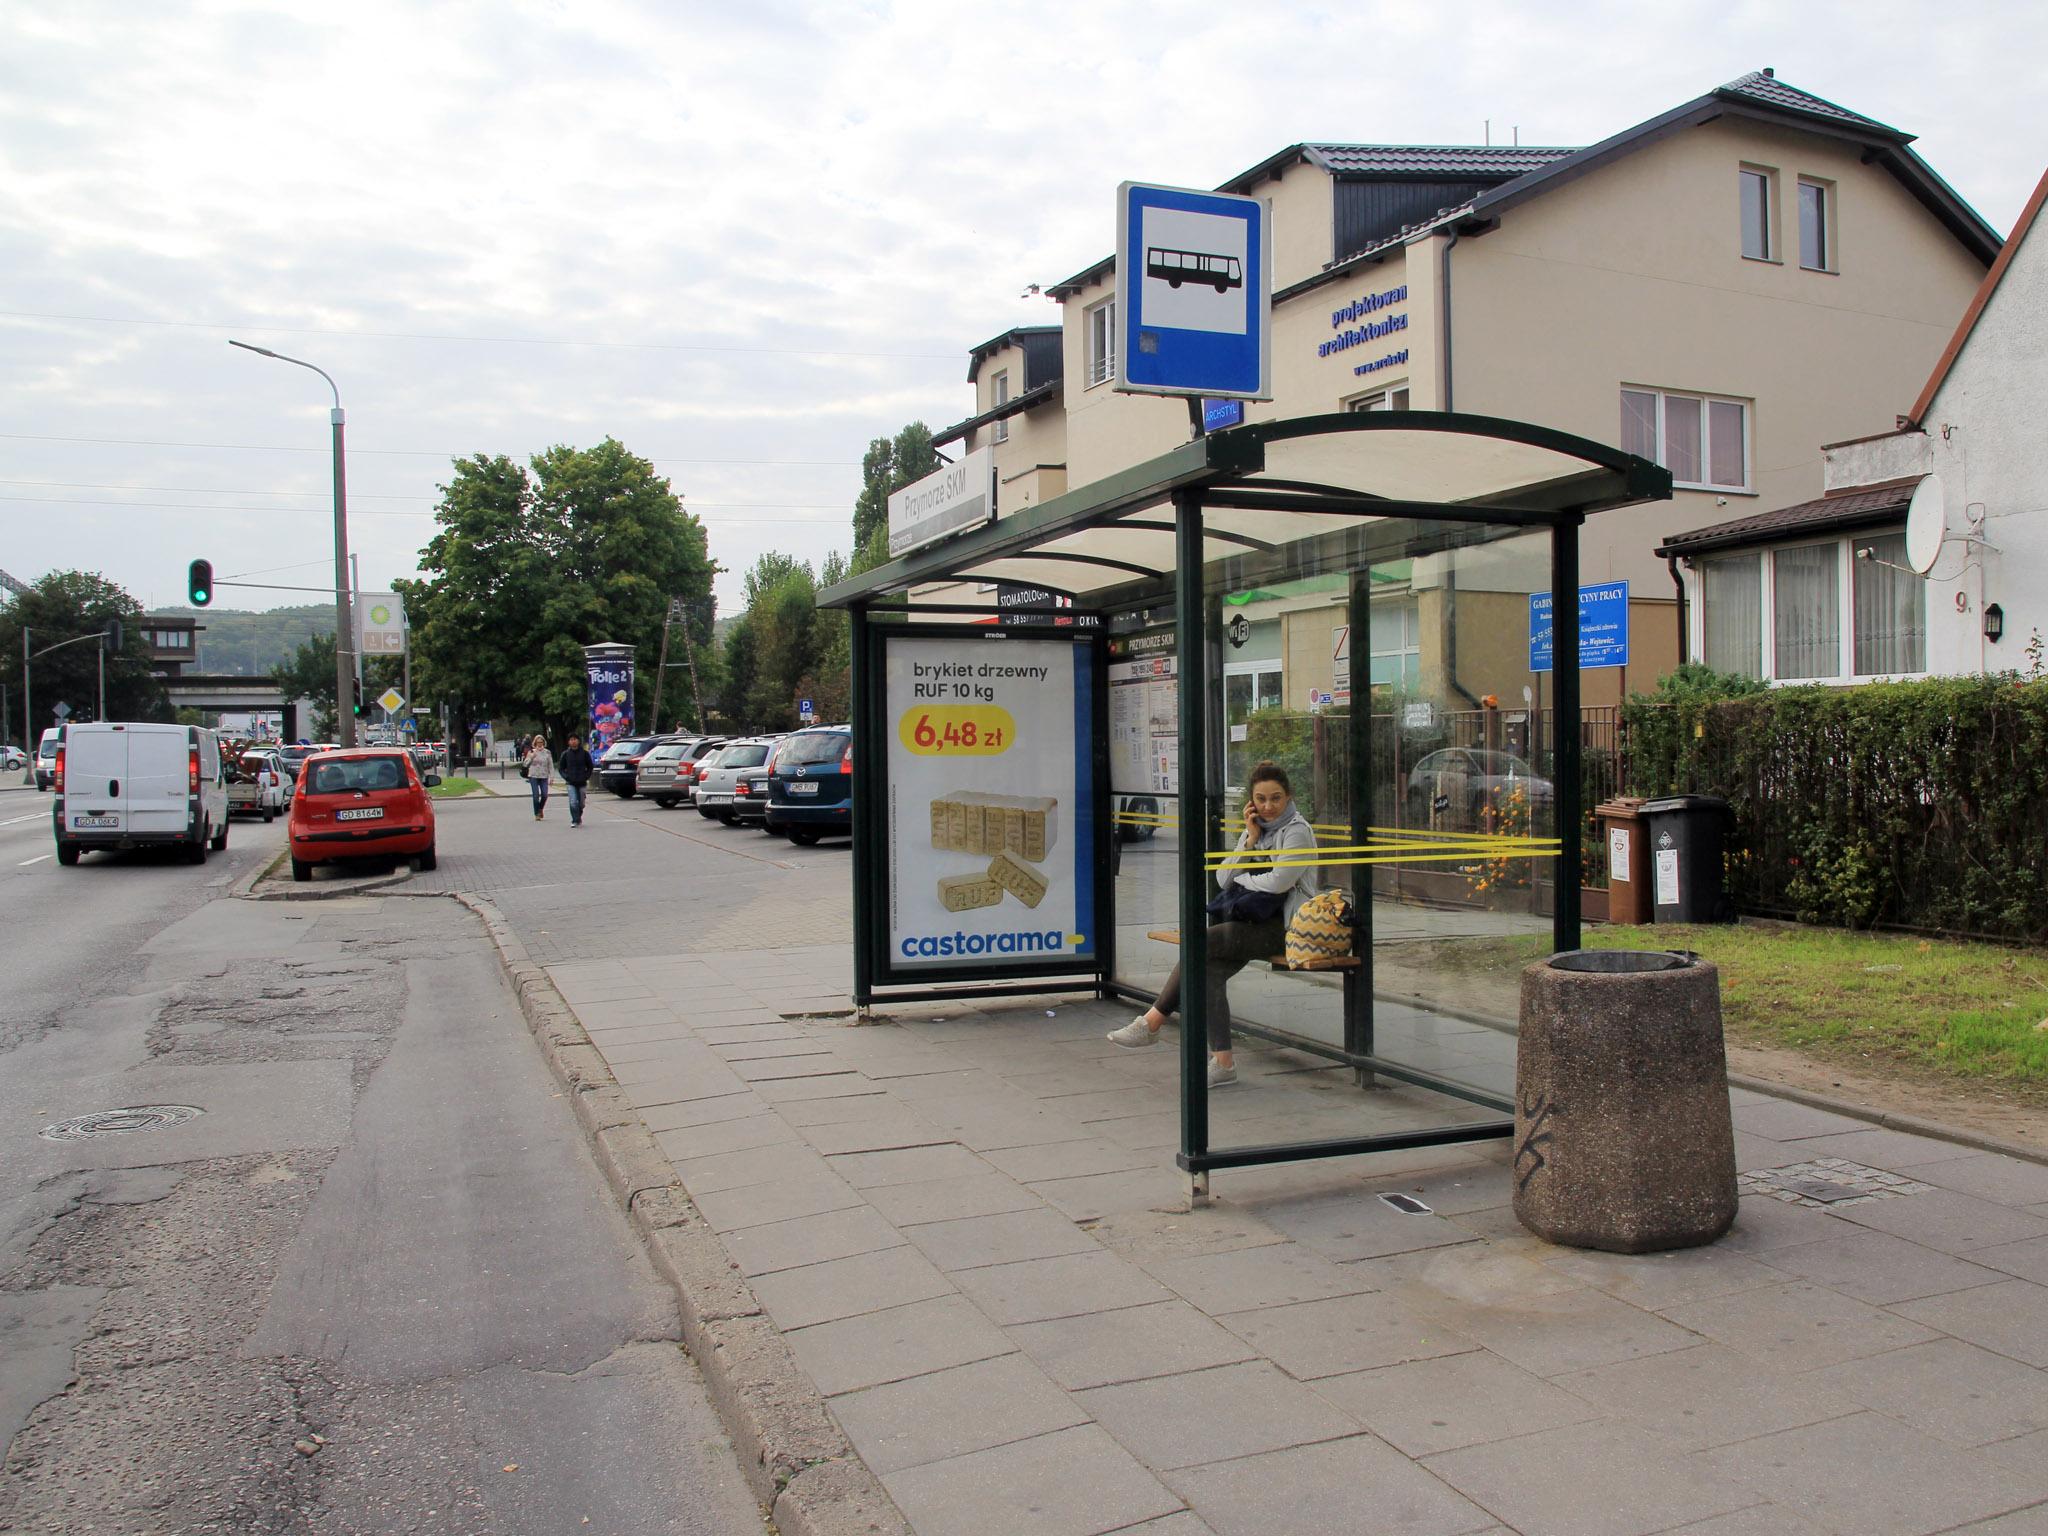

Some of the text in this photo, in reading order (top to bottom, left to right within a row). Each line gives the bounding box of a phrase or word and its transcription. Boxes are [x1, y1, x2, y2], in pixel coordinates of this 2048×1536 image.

[905, 467, 966, 520] Przymorze SKM
[1600, 588, 1623, 601] PRACY
[1955, 591, 1967, 613] 9
[588, 669, 620, 684] Trolle
[620, 670, 628, 682] 2
[914, 662, 1048, 681] brykiet drzewny
[914, 683, 994, 702] RUF 10 kg
[914, 714, 1003, 751] 6,48 zł
[341, 810, 354, 820] GD
[901, 931, 1062, 957] castorama
